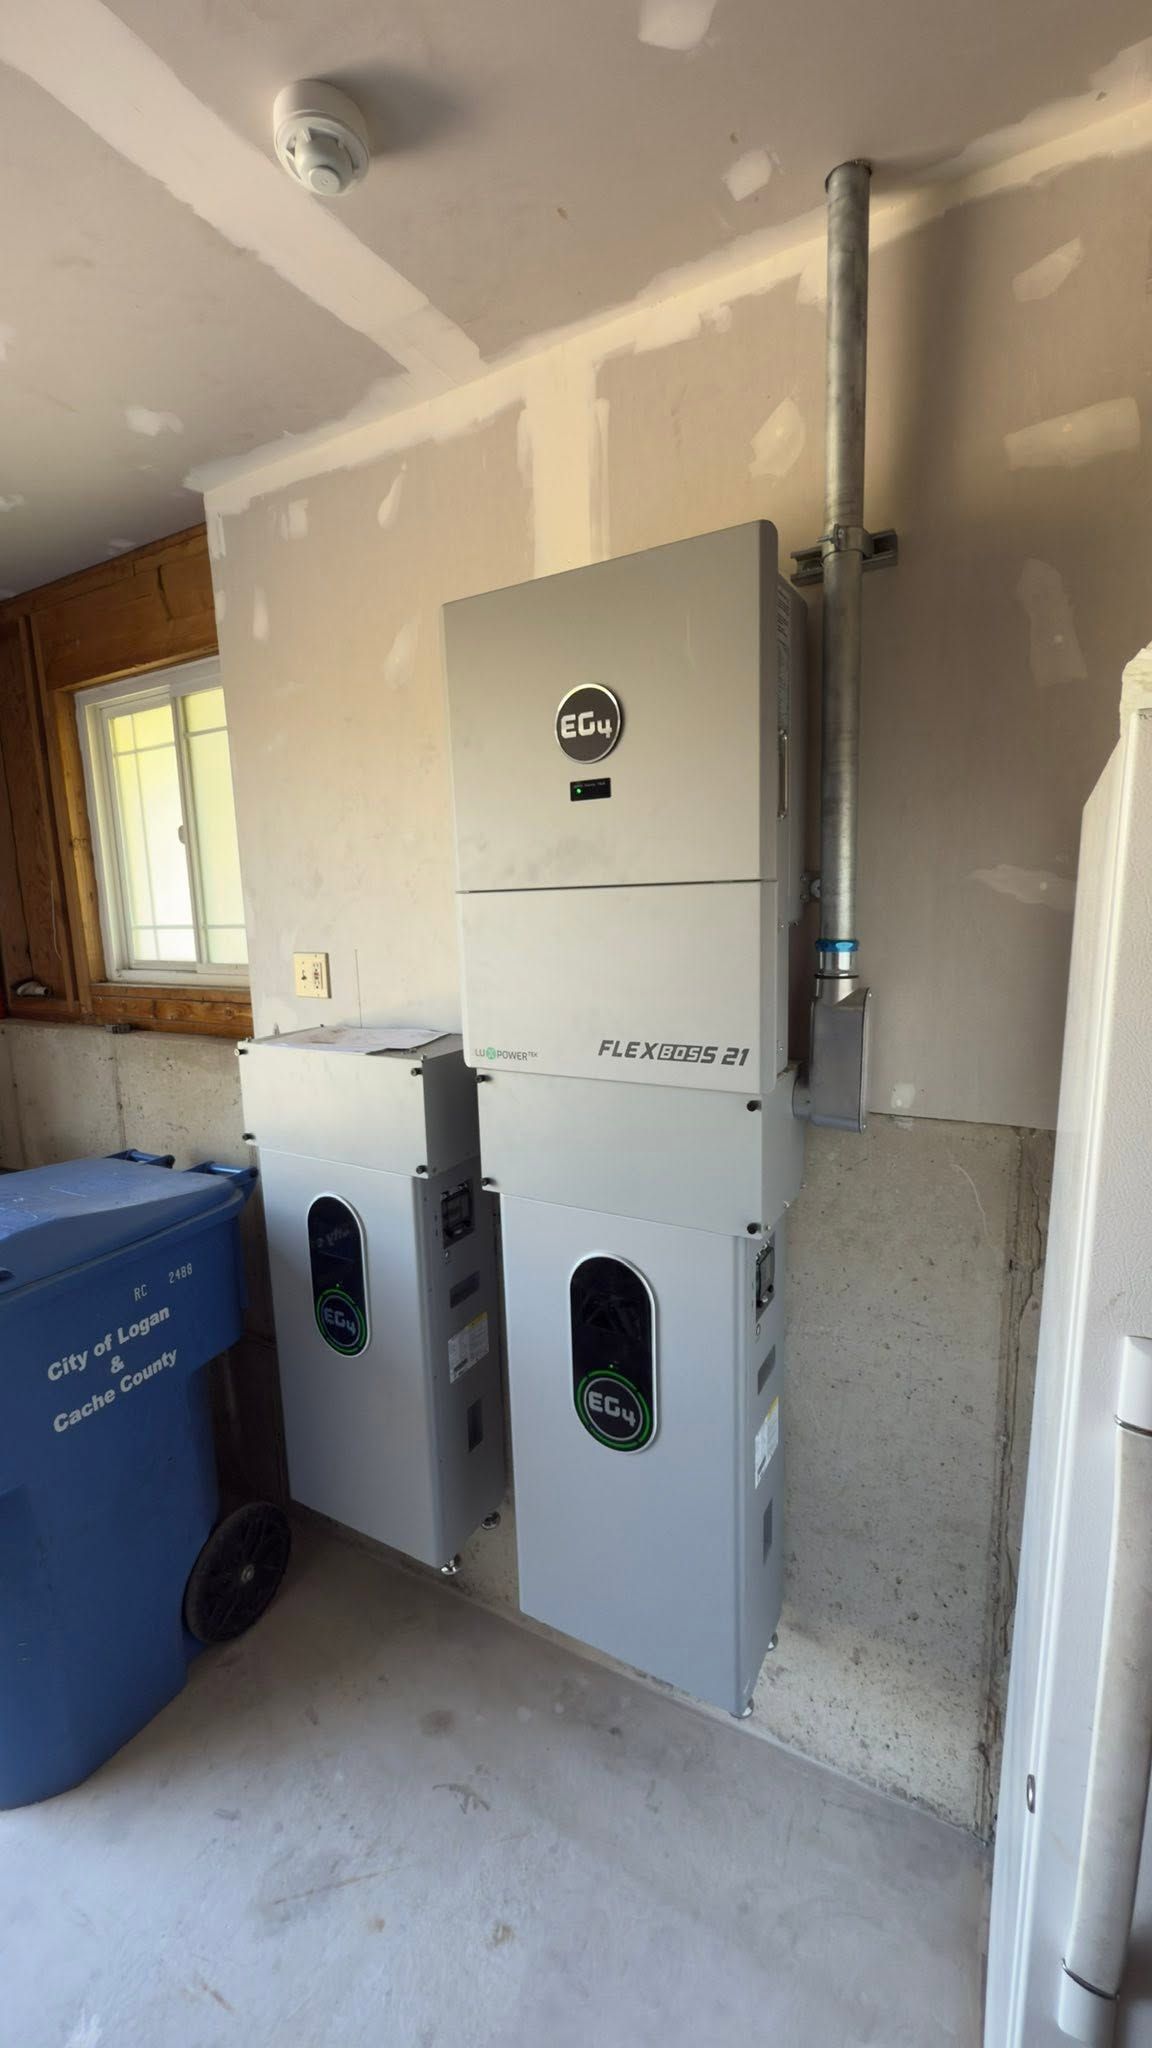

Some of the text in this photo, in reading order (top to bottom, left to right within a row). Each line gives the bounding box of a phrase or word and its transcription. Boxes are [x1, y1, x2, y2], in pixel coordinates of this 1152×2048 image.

[561, 711, 612, 739] EG4
[721, 1048, 750, 1066] 21
[134, 1284, 148, 1301] RC
[324, 1307, 356, 1335] EG4
[47, 1306, 170, 1381] City of Logan
[110, 1355, 125, 1374] &
[53, 1350, 177, 1432] Cache County
[588, 1391, 636, 1427] EG4
